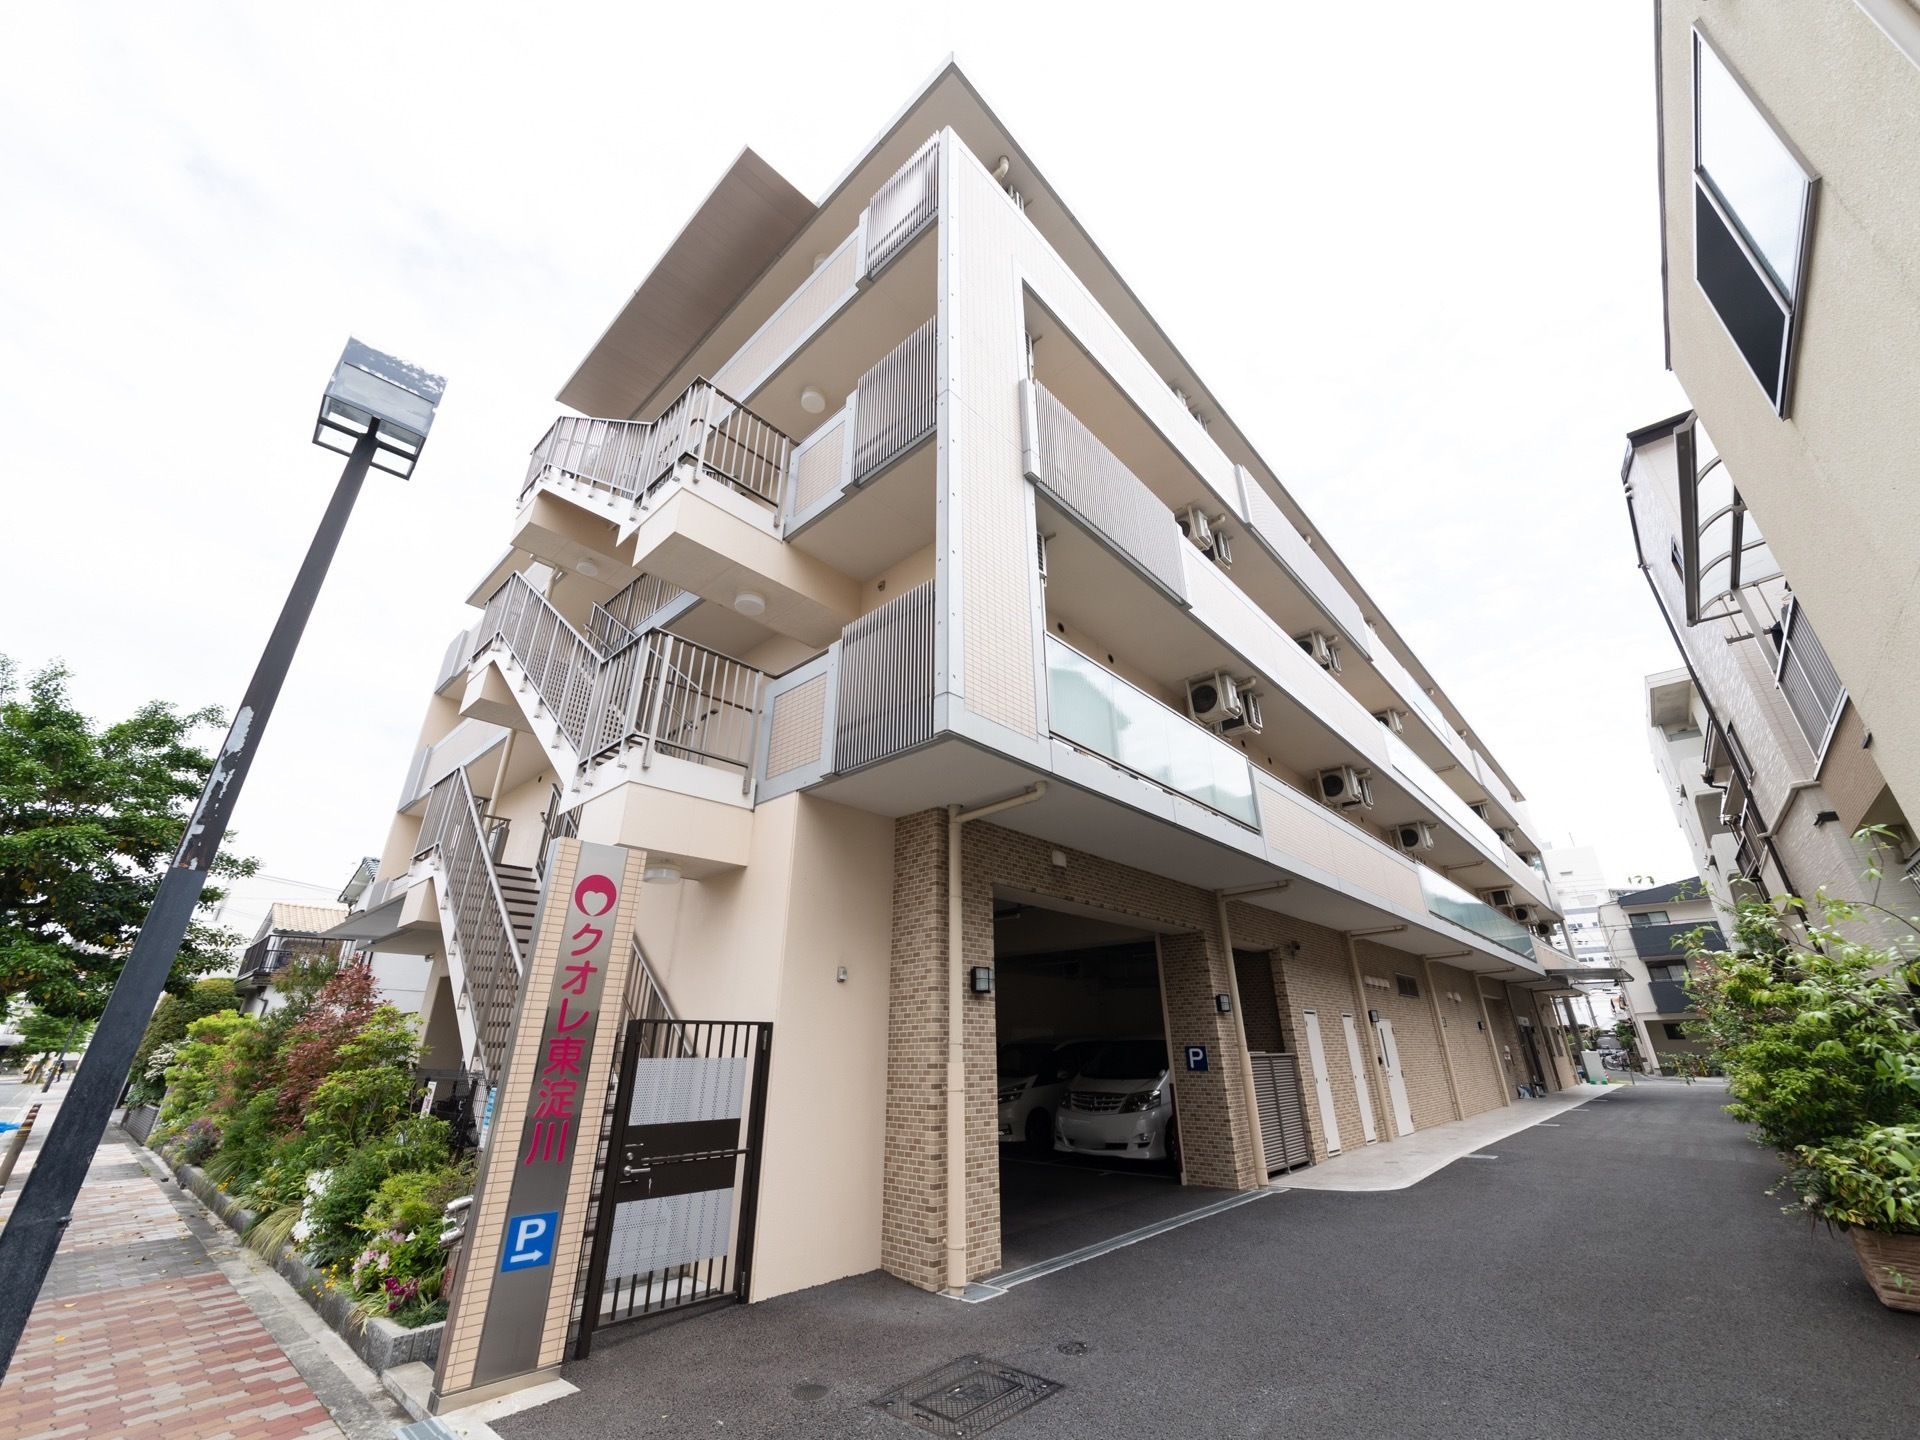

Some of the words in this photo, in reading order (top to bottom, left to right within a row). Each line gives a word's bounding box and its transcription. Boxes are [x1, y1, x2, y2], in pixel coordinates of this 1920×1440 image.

[524, 923, 603, 1165] クオレ東淀川
[1189, 1048, 1203, 1068] P
[515, 1218, 546, 1251] P
